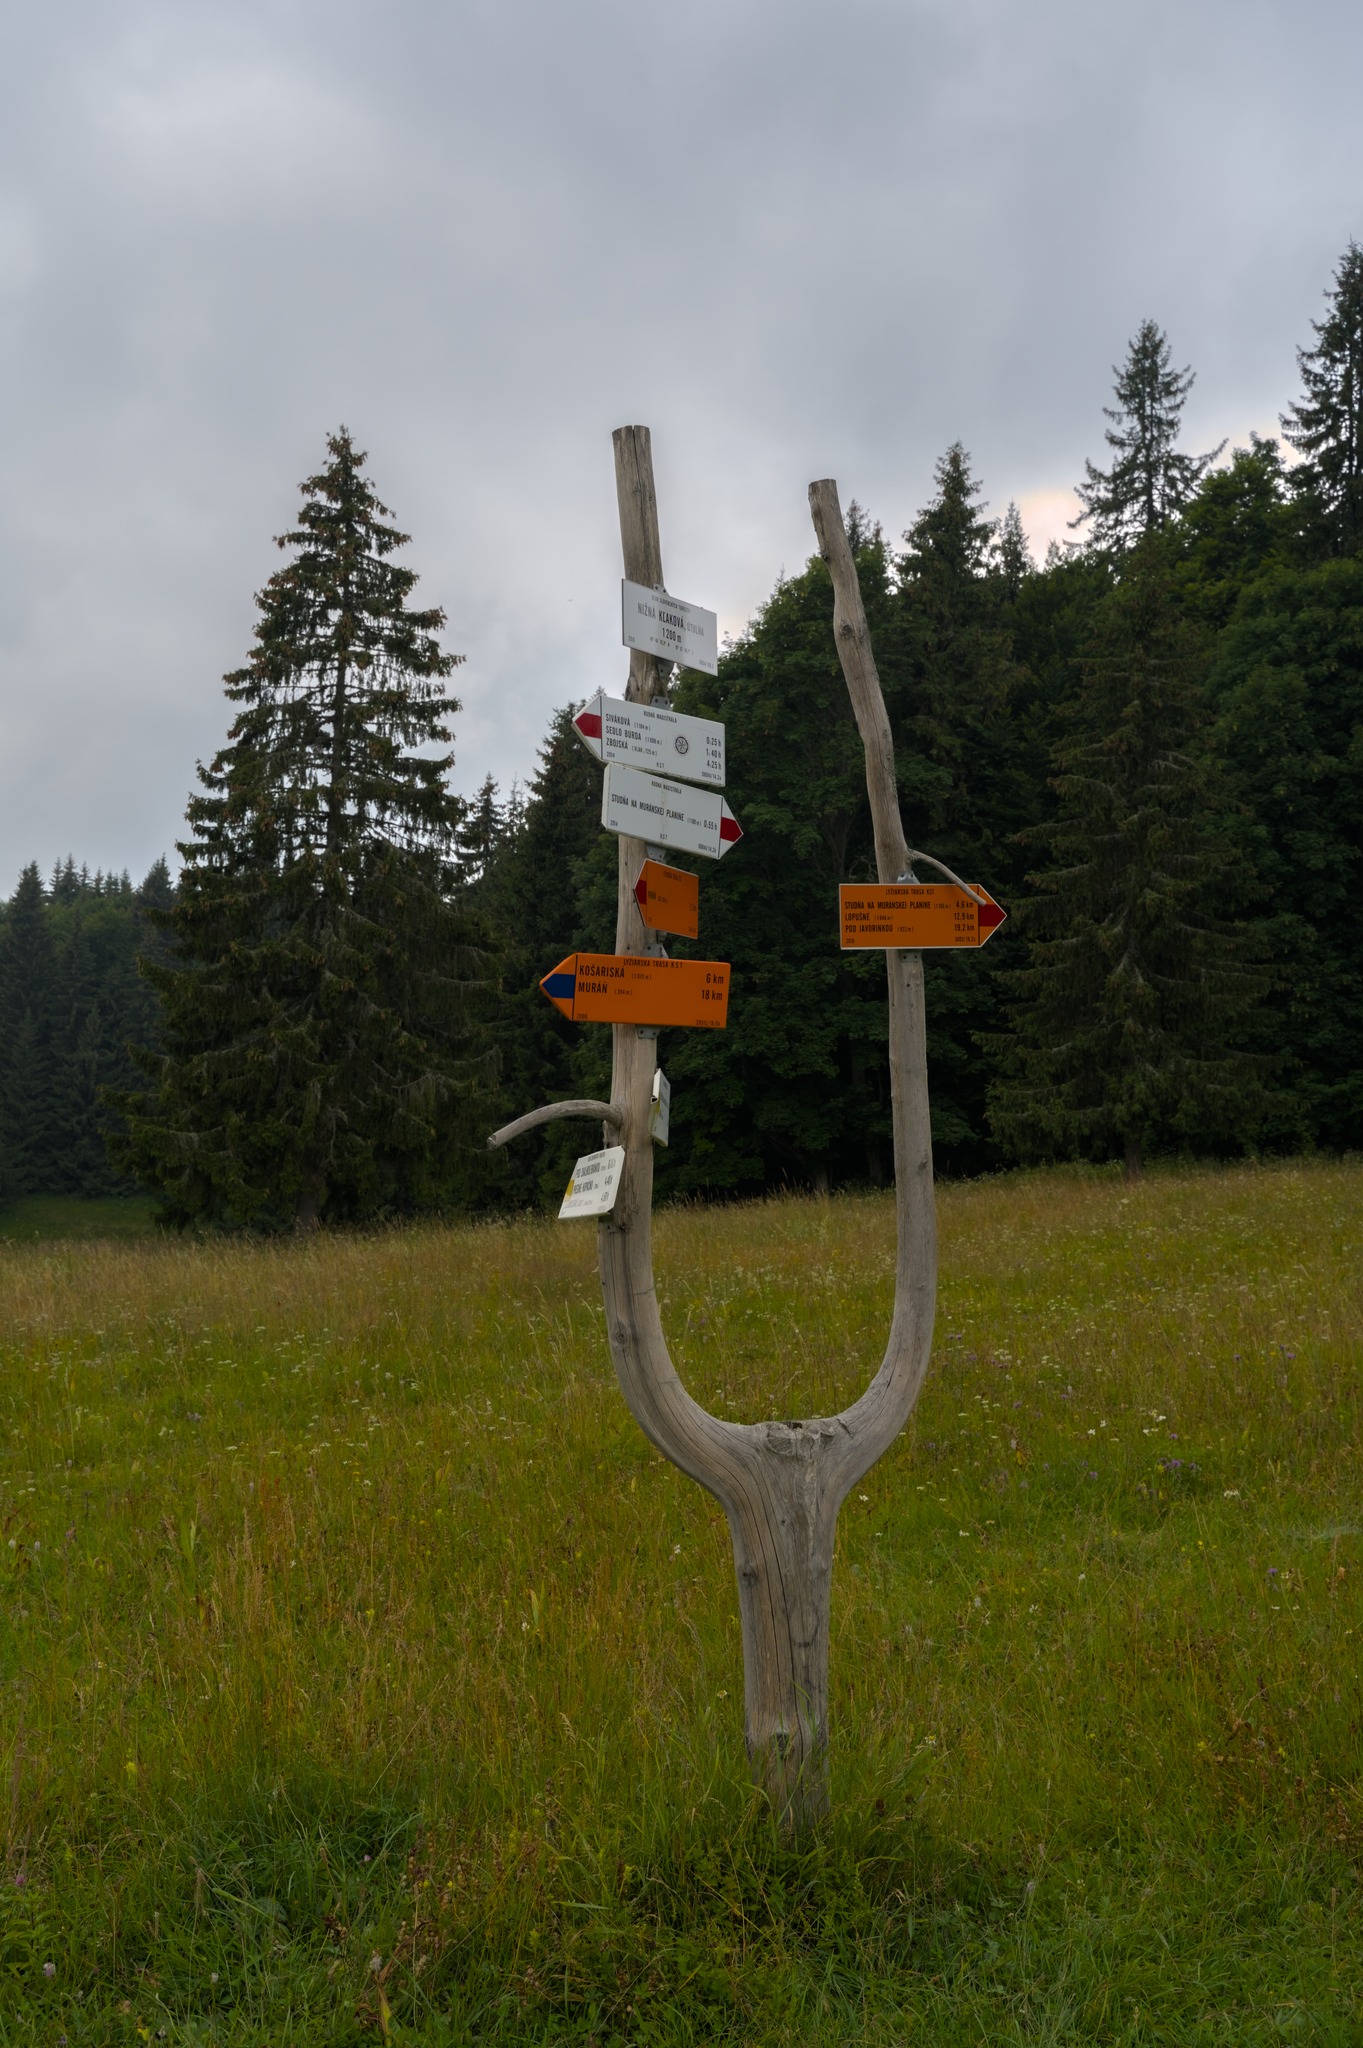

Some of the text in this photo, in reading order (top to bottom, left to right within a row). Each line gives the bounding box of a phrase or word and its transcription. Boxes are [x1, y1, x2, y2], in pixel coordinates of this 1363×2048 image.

[638, 602, 656, 619] NIŽNÁ
[606, 713, 630, 726] SIVÁKOVÁ
[606, 725, 622, 736] SEDLO
[625, 730, 641, 740] BURDA
[606, 737, 628, 750] ZBOJSKÁ
[718, 739, 721, 747] h
[718, 751, 721, 759] h
[611, 794, 629, 805] STUDŇA
[631, 799, 637, 808] NA
[666, 809, 684, 821] PLANINE
[714, 822, 718, 831] h
[845, 900, 864, 909] STUDŇA
[868, 901, 874, 909] NA
[910, 901, 931, 909] PLANINE
[966, 901, 974, 909] km
[954, 912, 966, 921] 12,9
[845, 925, 856, 933] POD
[859, 924, 893, 932] JAVORINKOU
[624, 958, 650, 967] LYŽIARSKA
[653, 960, 668, 968] TRASA
[579, 963, 625, 978] KOŠARISKÁ
[706, 973, 724, 984] 6 km
[578, 981, 607, 994] MURÁŇ
[702, 989, 723, 1000] 18 km
